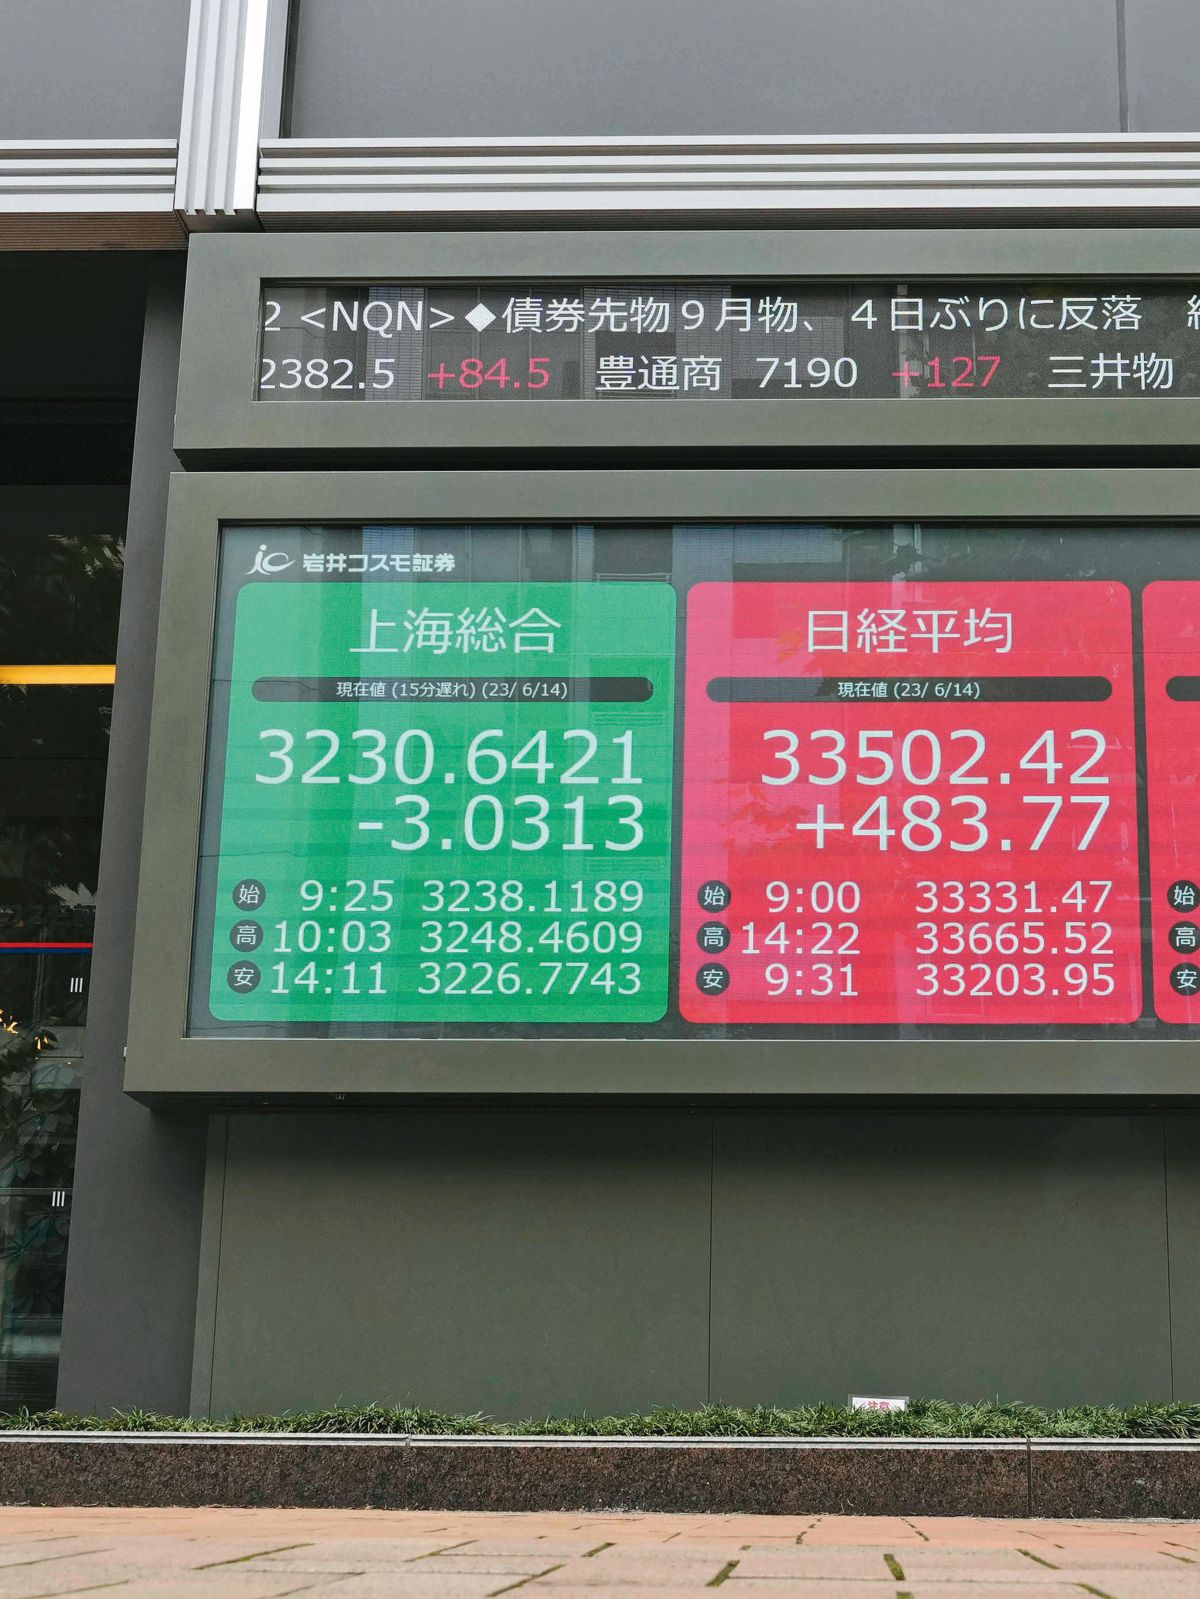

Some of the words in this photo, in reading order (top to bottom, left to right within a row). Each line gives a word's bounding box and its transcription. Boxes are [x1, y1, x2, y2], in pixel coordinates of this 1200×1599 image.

[260, 358, 396, 389] 2382.5
[429, 357, 549, 389] +84.5
[595, 354, 723, 391] 豊通商
[756, 357, 858, 388] 7190
[893, 355, 1001, 388] +127
[1048, 352, 1173, 391] 三井物
[302, 552, 456, 573] 岩井コスモ証券
[349, 607, 561, 655] 上海総合
[807, 607, 1013, 654] 日経平均
[336, 681, 387, 697] 現在値
[837, 681, 888, 698] 現在値
[255, 728, 643, 785] 3230.6421
[761, 728, 1110, 786] 33502.42
[358, 794, 644, 851] -3.0313
[796, 794, 1110, 852] +483.77
[238, 884, 260, 904] 始
[300, 879, 394, 912] 9:25
[422, 879, 644, 913] 3238.1189
[703, 885, 725, 906] 始
[766, 880, 861, 914] 9:00
[915, 880, 1113, 914] 33331.47
[1173, 885, 1195, 906] 始
[236, 925, 257, 945] 高
[273, 920, 391, 953] 10:03
[420, 920, 643, 954] 3248.4609
[703, 927, 724, 947] 高
[742, 921, 860, 955] 14:22
[916, 921, 1114, 955] 33665.52
[1175, 926, 1196, 947] 高
[234, 967, 254, 986] 安
[271, 961, 387, 994] 14:11
[418, 961, 641, 995] 3226.7743
[703, 969, 723, 989] 安
[764, 963, 858, 996] 9:31
[916, 963, 1115, 996] 33203.95
[1176, 969, 1198, 989] 安
